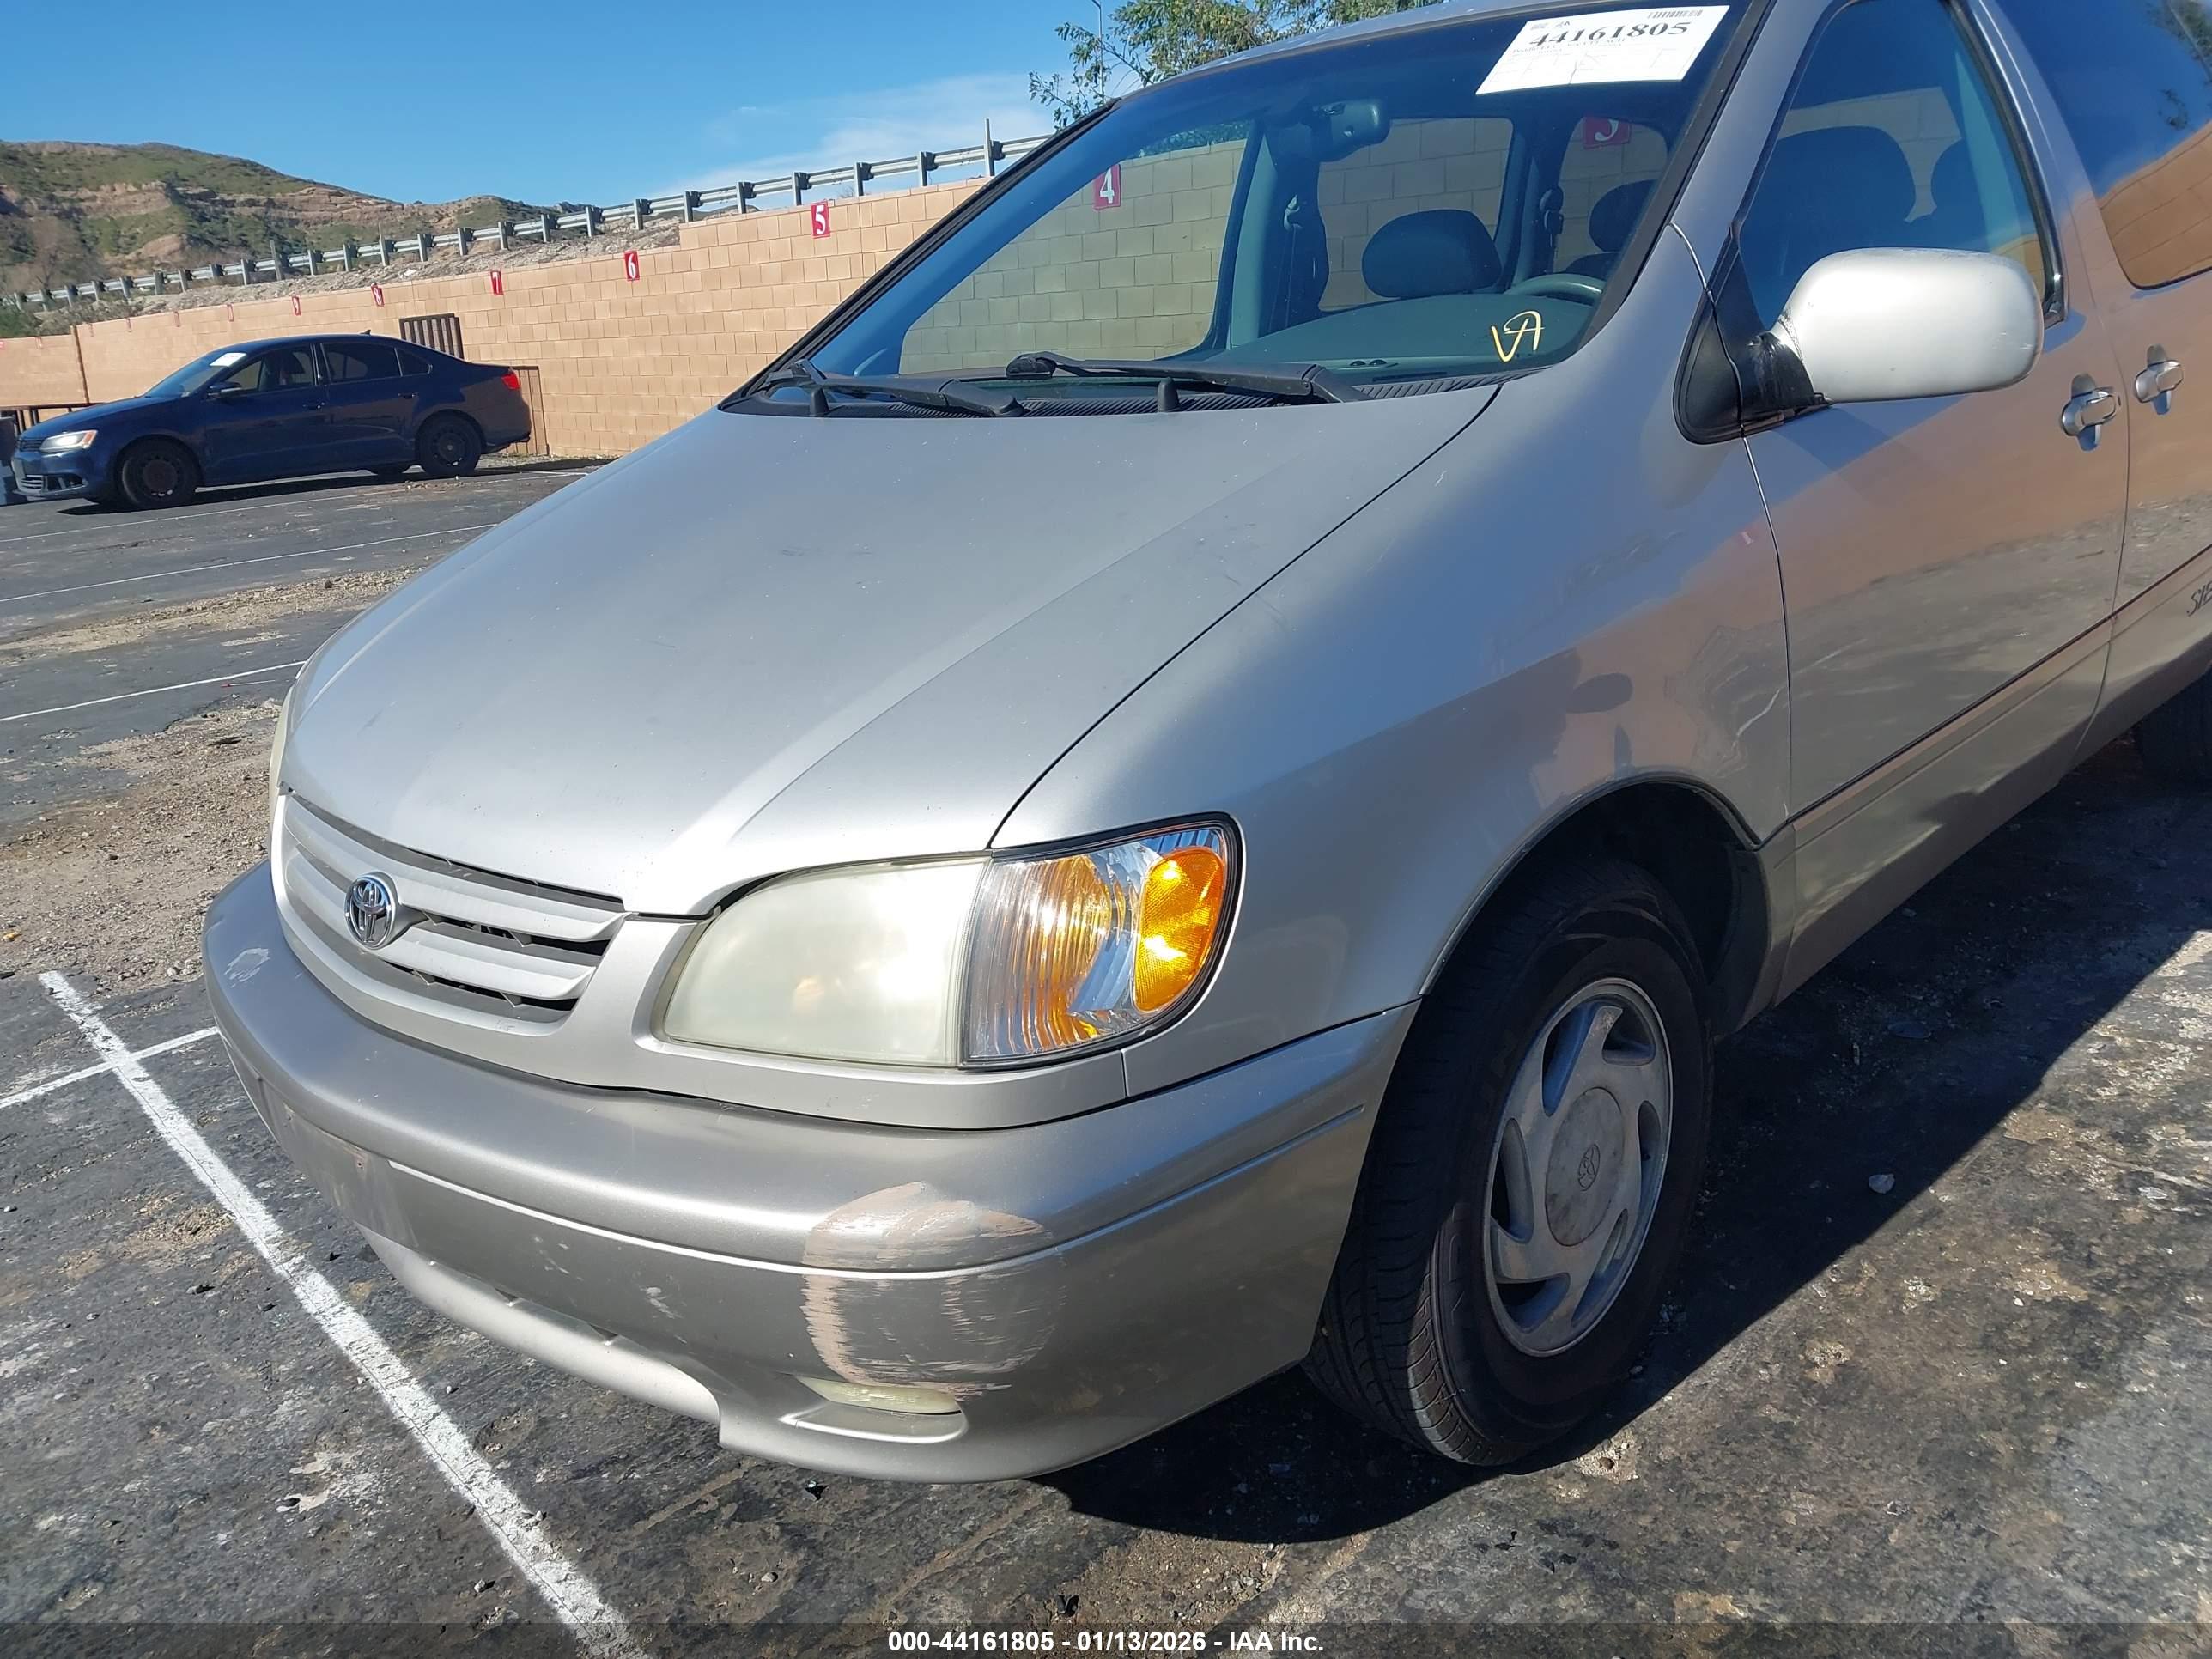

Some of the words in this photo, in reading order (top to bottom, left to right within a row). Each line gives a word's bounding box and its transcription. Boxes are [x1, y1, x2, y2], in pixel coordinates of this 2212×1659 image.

[1529, 22, 1691, 46] 44161805
[1099, 168, 1115, 204] 4
[815, 204, 826, 235] 5
[628, 252, 636, 279] 6
